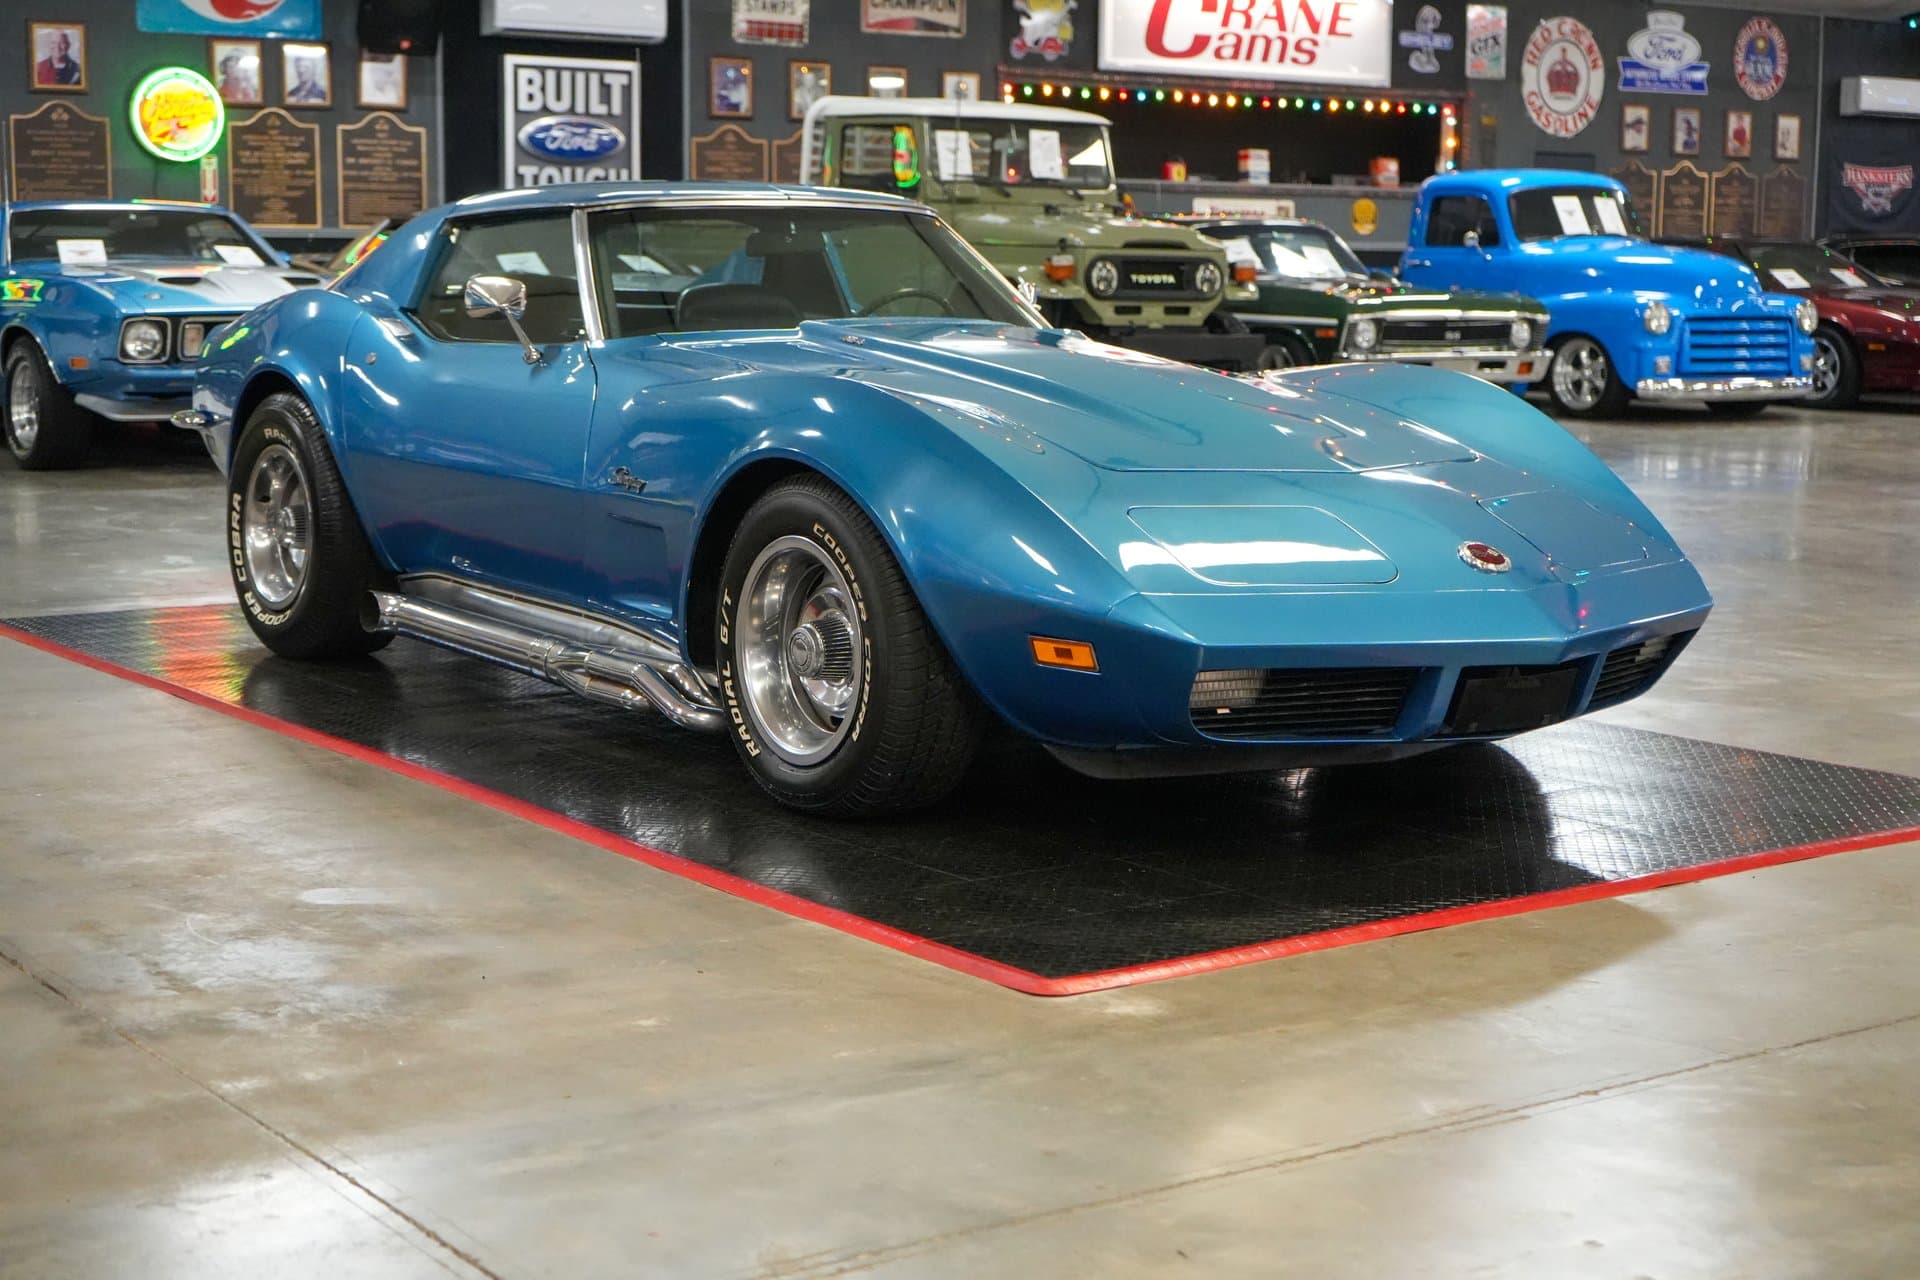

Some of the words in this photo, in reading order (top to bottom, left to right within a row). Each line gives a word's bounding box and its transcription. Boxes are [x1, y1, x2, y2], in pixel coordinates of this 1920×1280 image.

[517, 67, 629, 116] BUILT
[1526, 91, 1598, 134] GASOLINE
[543, 123, 603, 152] Ford
[1129, 273, 1176, 285] TOYOTA
[231, 493, 248, 583] COBRA
[244, 592, 292, 626] COOPER
[719, 587, 732, 645] G/T
[813, 521, 868, 623] COOPER
[851, 637, 873, 742] COBRA
[723, 659, 761, 758] RADIAL
